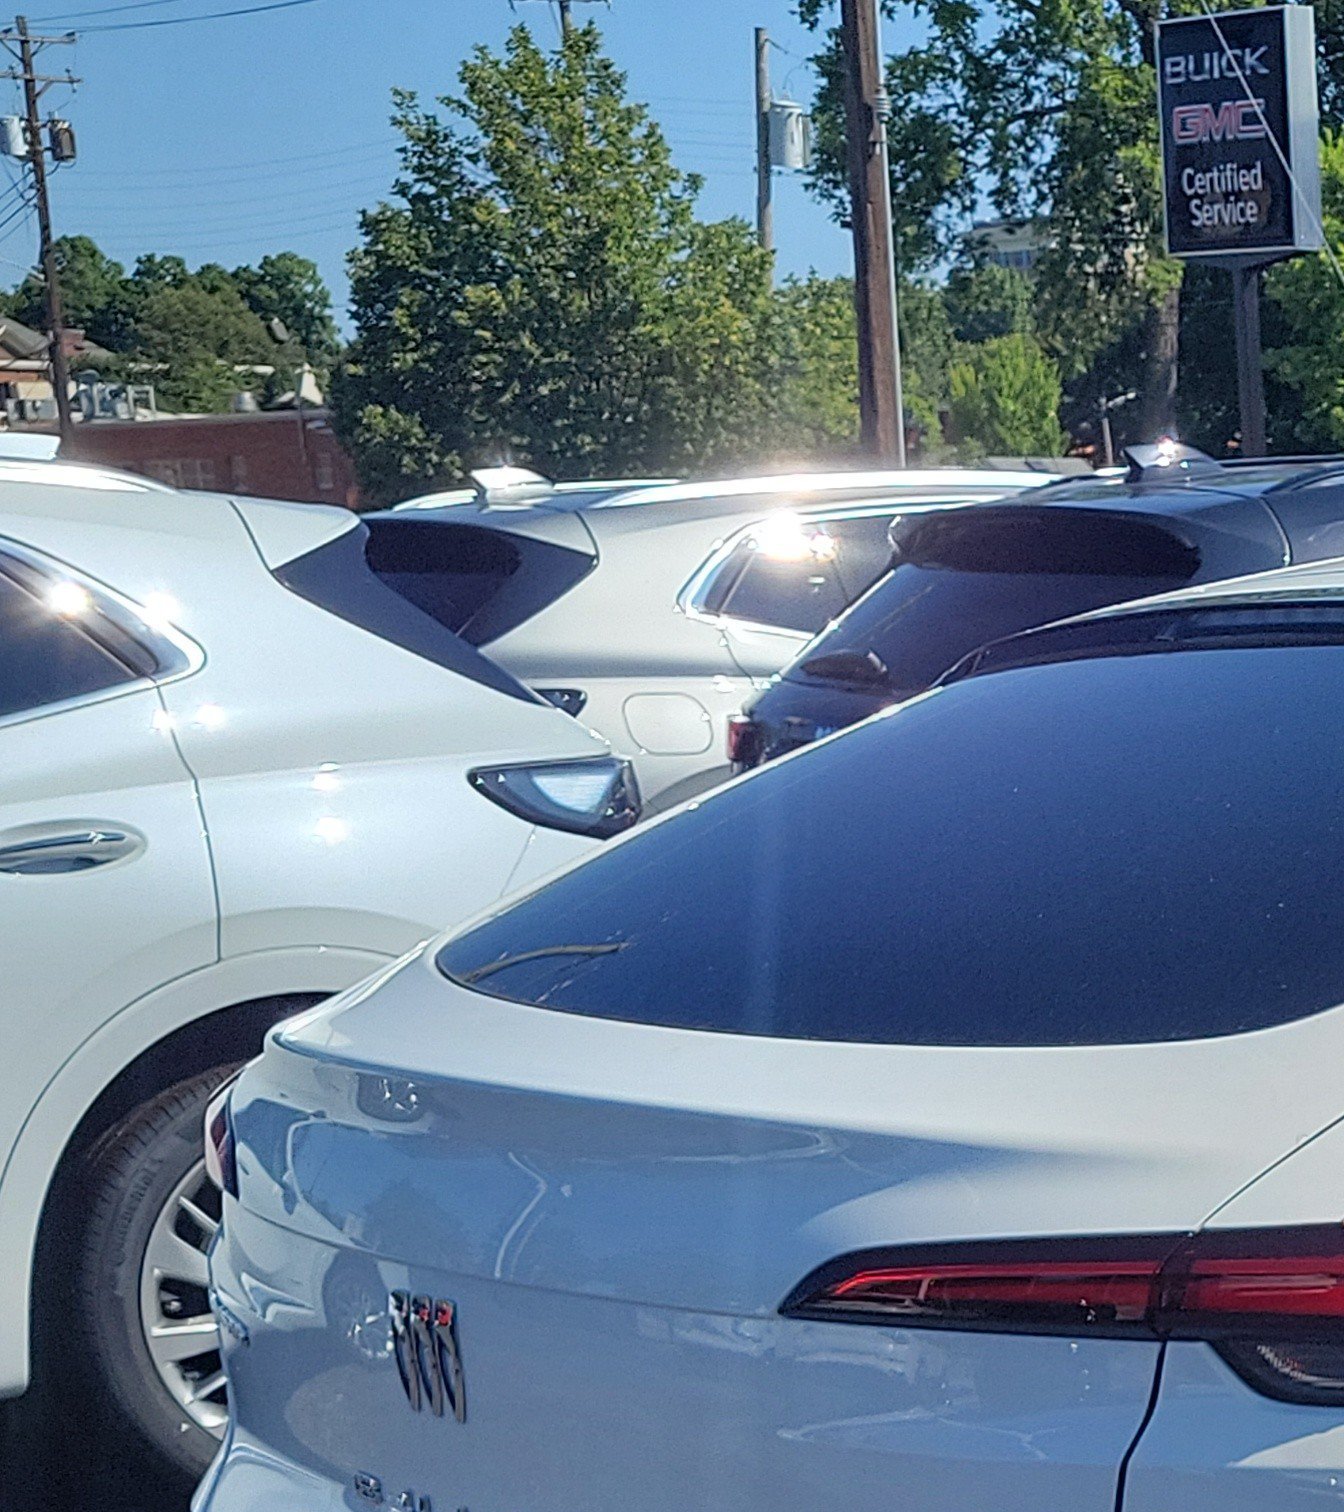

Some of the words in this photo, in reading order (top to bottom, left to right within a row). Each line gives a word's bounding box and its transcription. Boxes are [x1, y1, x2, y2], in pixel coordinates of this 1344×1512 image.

[1164, 45, 1270, 85] BUICK
[1172, 98, 1267, 145] GMC
[1181, 160, 1263, 196] Certified
[1189, 195, 1259, 228] Service
